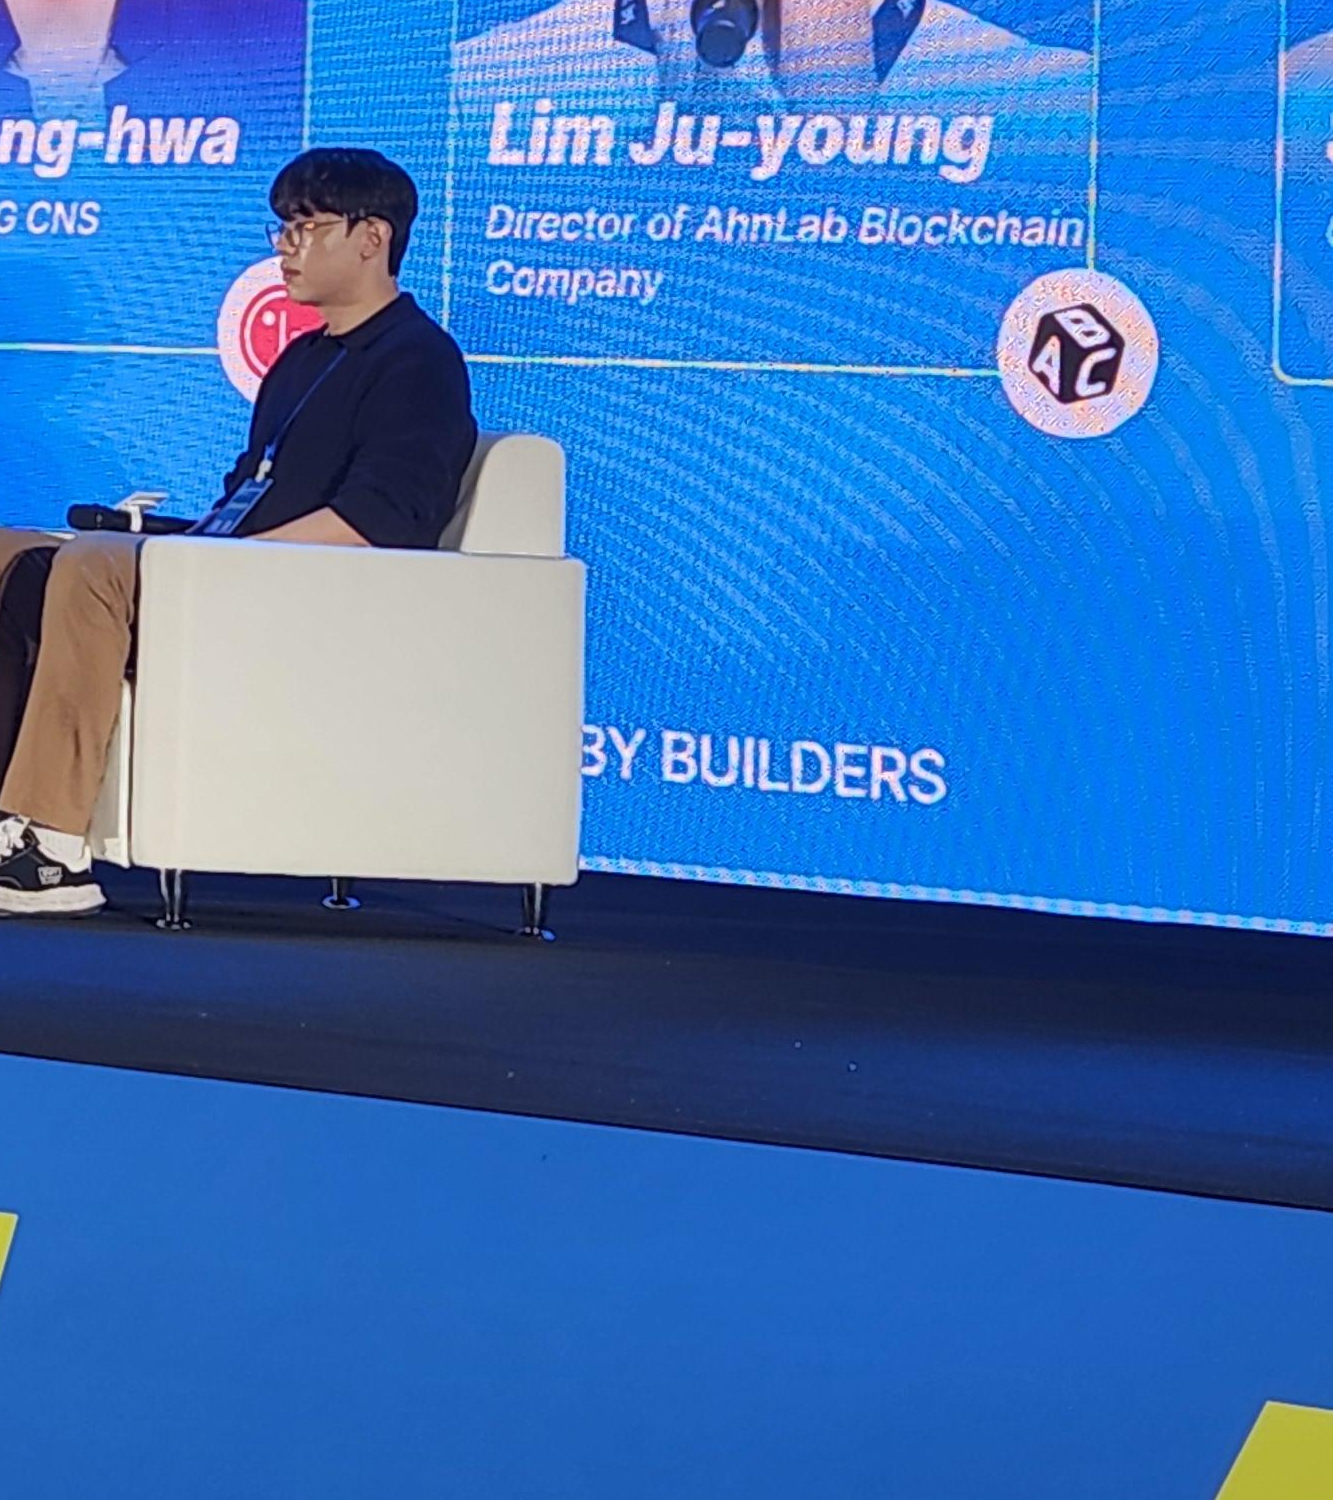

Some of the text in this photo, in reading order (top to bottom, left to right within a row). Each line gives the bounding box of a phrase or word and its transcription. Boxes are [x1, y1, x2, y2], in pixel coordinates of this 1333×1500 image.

[486, 100, 994, 184] Lim Ju-young
[25, 200, 102, 236] CNS
[486, 203, 1085, 249] Director of AhnLab Blockchain
[485, 259, 665, 307] Company
[580, 724, 950, 806] BY BUILDERS
